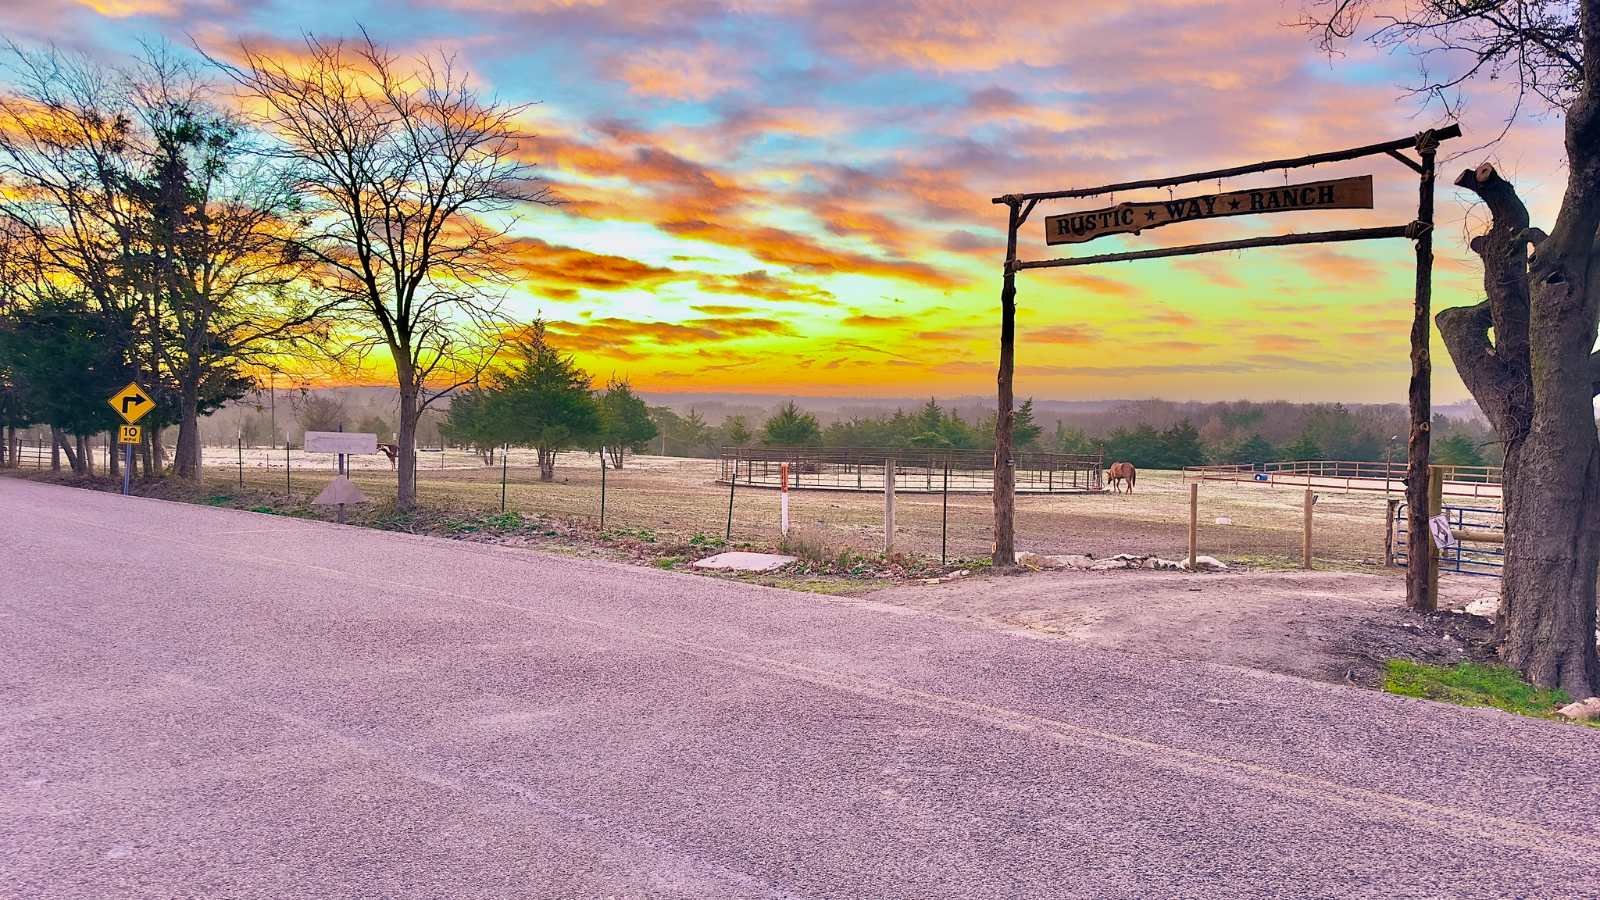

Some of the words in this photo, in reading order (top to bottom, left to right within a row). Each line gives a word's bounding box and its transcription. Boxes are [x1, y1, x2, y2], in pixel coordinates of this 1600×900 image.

[1056, 208, 1134, 236] RUSTIC
[1167, 196, 1216, 218] WAY
[1248, 185, 1335, 210] RANCH
[123, 427, 137, 437] 10
